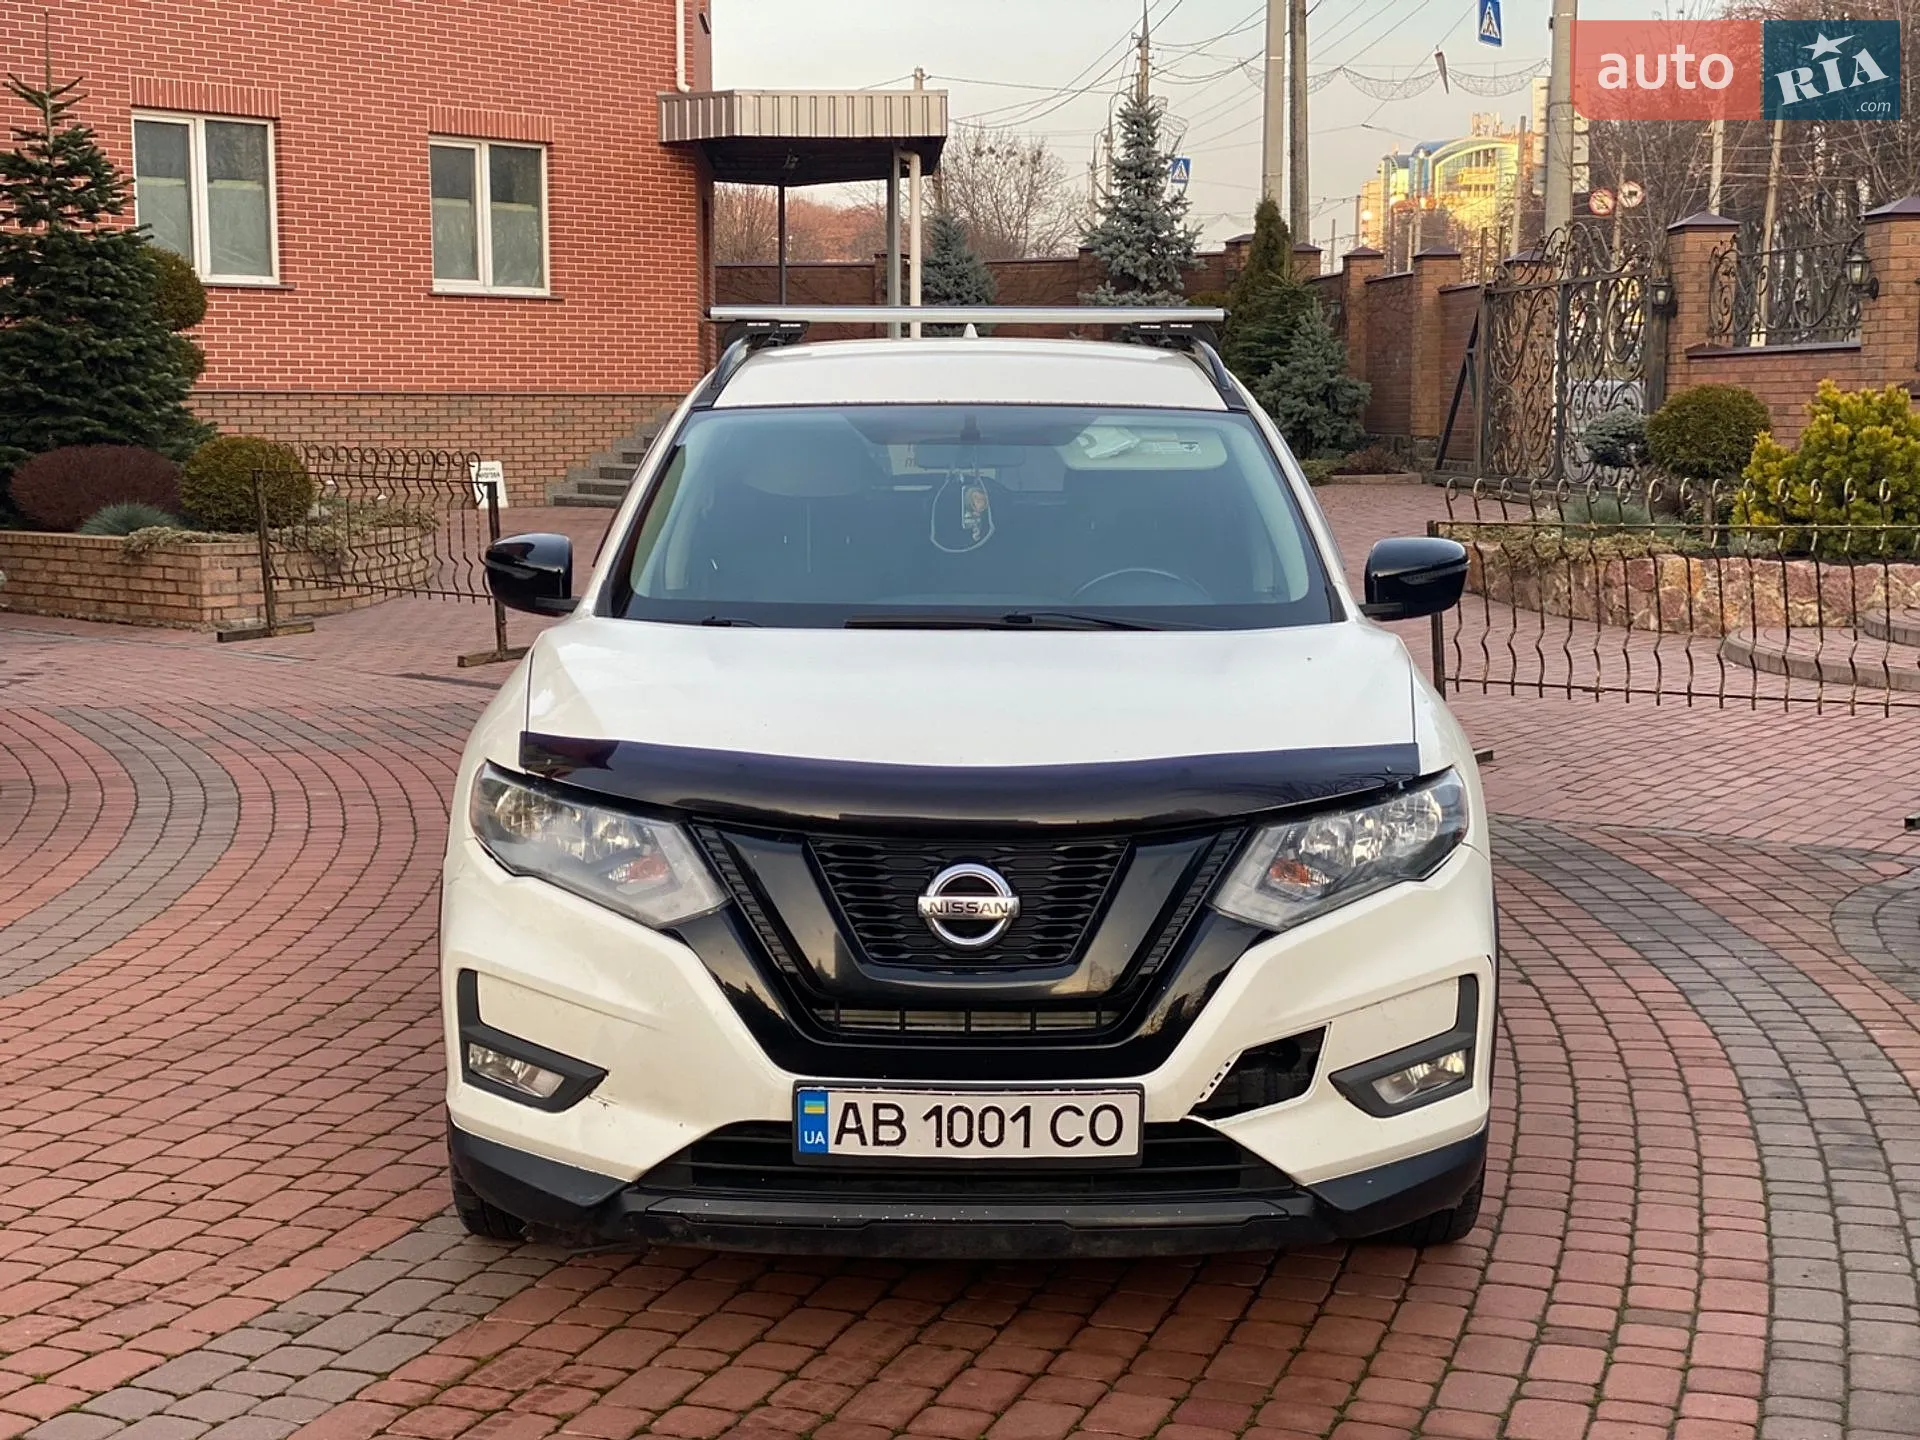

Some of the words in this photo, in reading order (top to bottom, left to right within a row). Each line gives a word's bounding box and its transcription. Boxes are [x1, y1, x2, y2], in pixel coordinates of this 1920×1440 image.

[929, 902, 1008, 914] NISSAN
[834, 1102, 907, 1147] AB
[922, 1105, 1032, 1149] 1001
[1050, 1104, 1123, 1148] CO
[804, 1131, 825, 1144] UA
